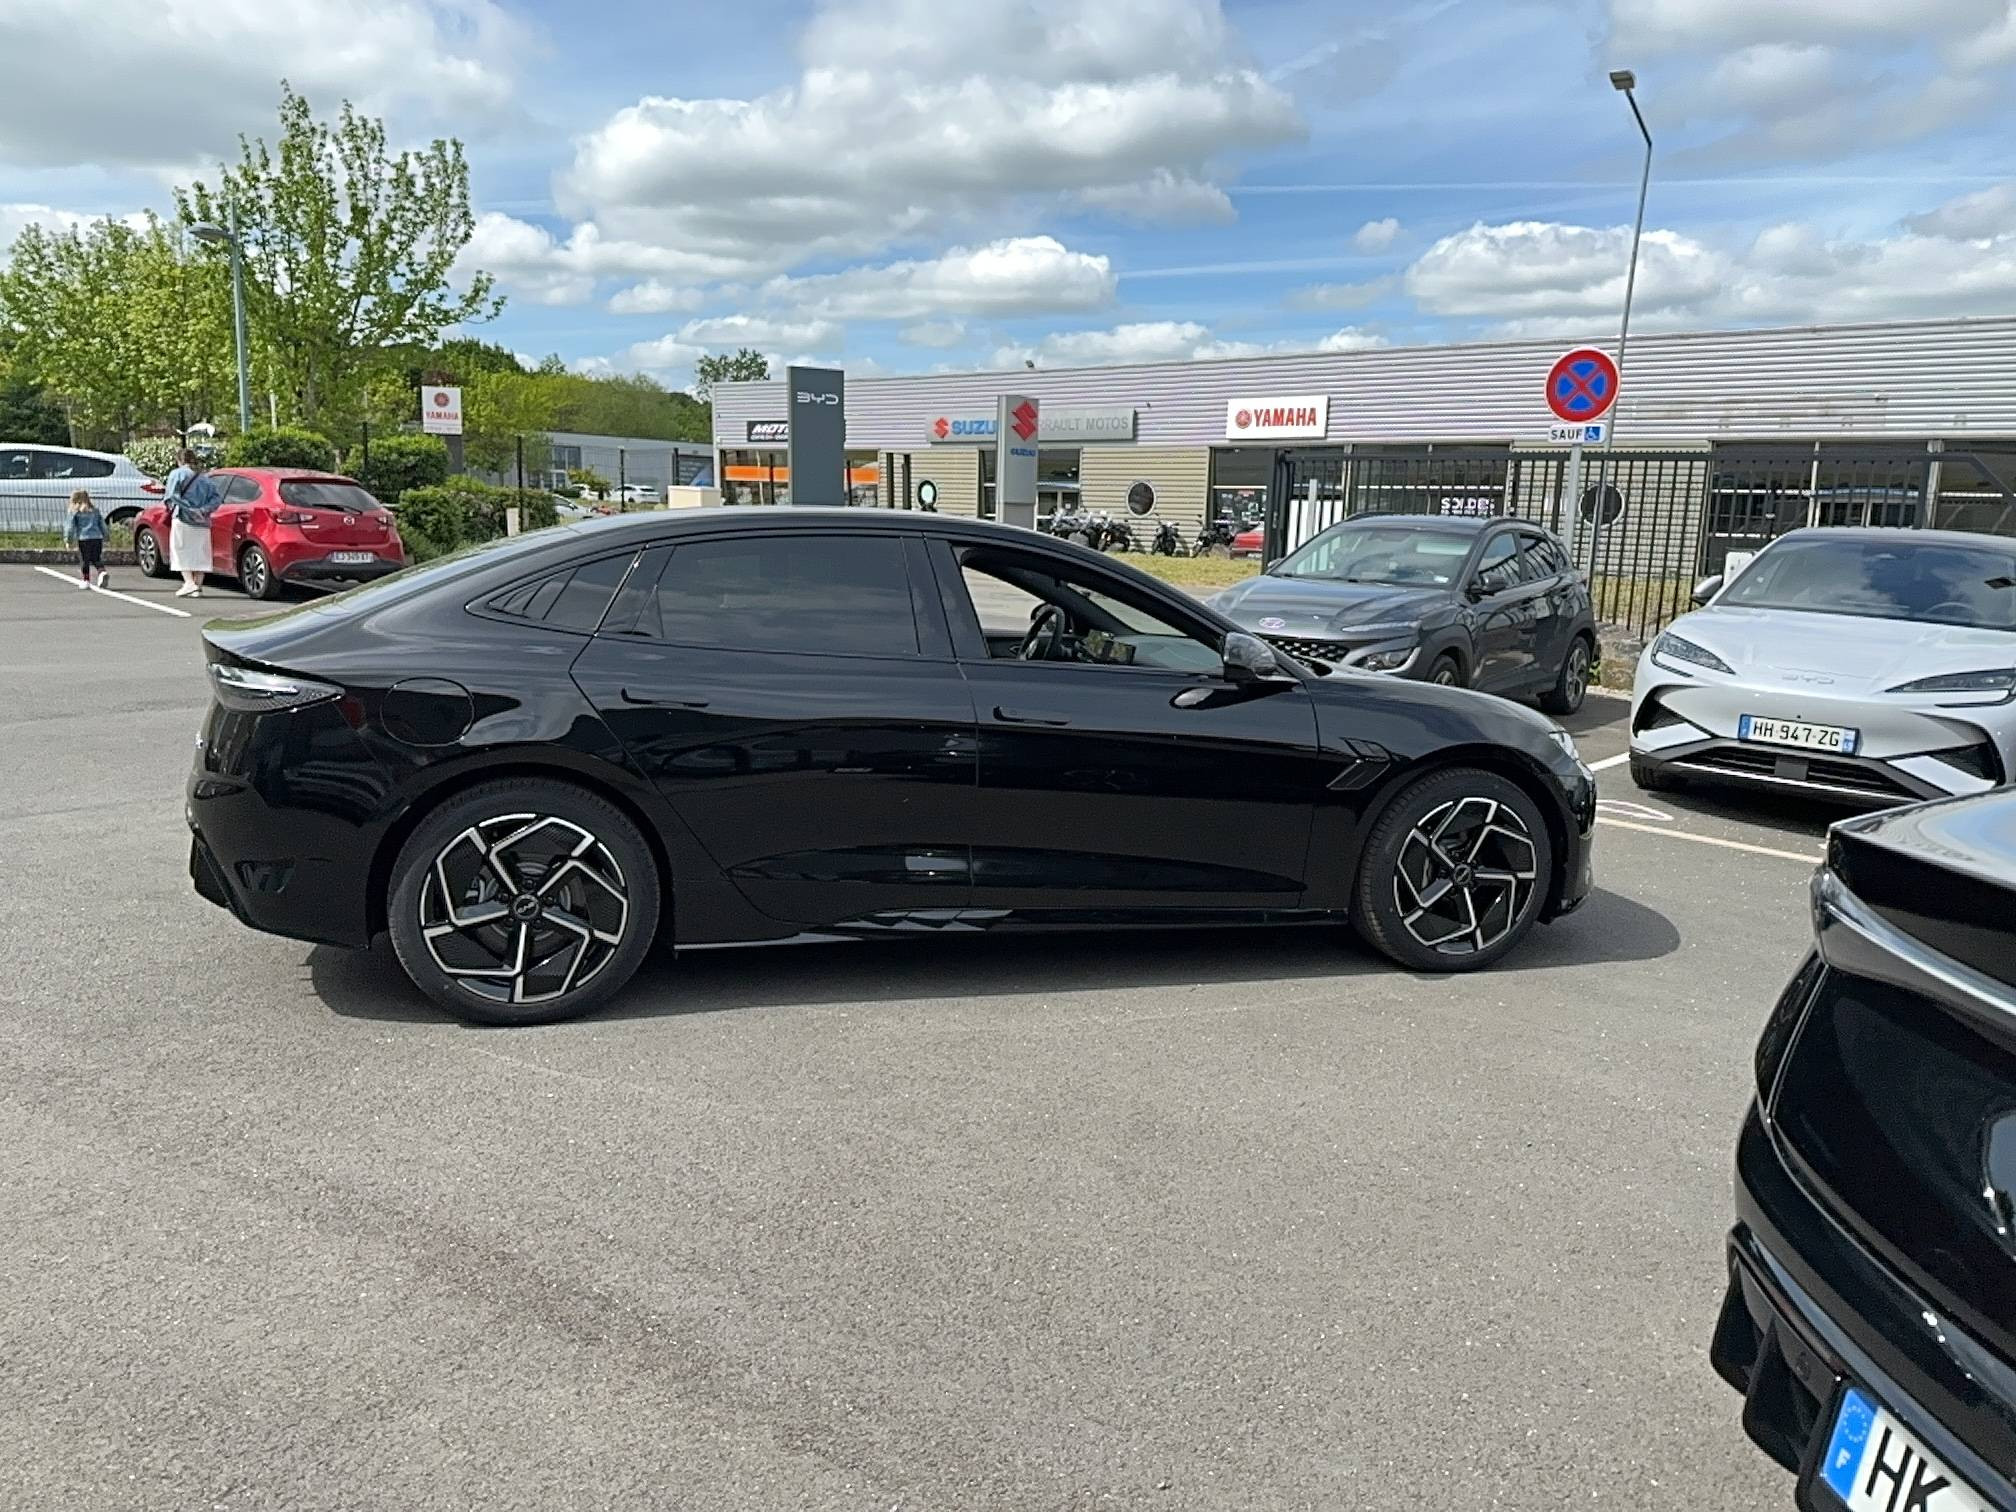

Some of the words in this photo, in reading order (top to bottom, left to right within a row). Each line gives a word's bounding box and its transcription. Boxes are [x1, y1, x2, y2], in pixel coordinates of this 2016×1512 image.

[796, 391, 839, 405] BYD
[425, 411, 459, 420] YAMAHA
[1253, 407, 1317, 427] YAMAHA
[751, 423, 789, 435] MOT
[951, 419, 998, 435] SUZU
[1086, 416, 1129, 431] MOTOS
[1551, 428, 1583, 440] SAUF
